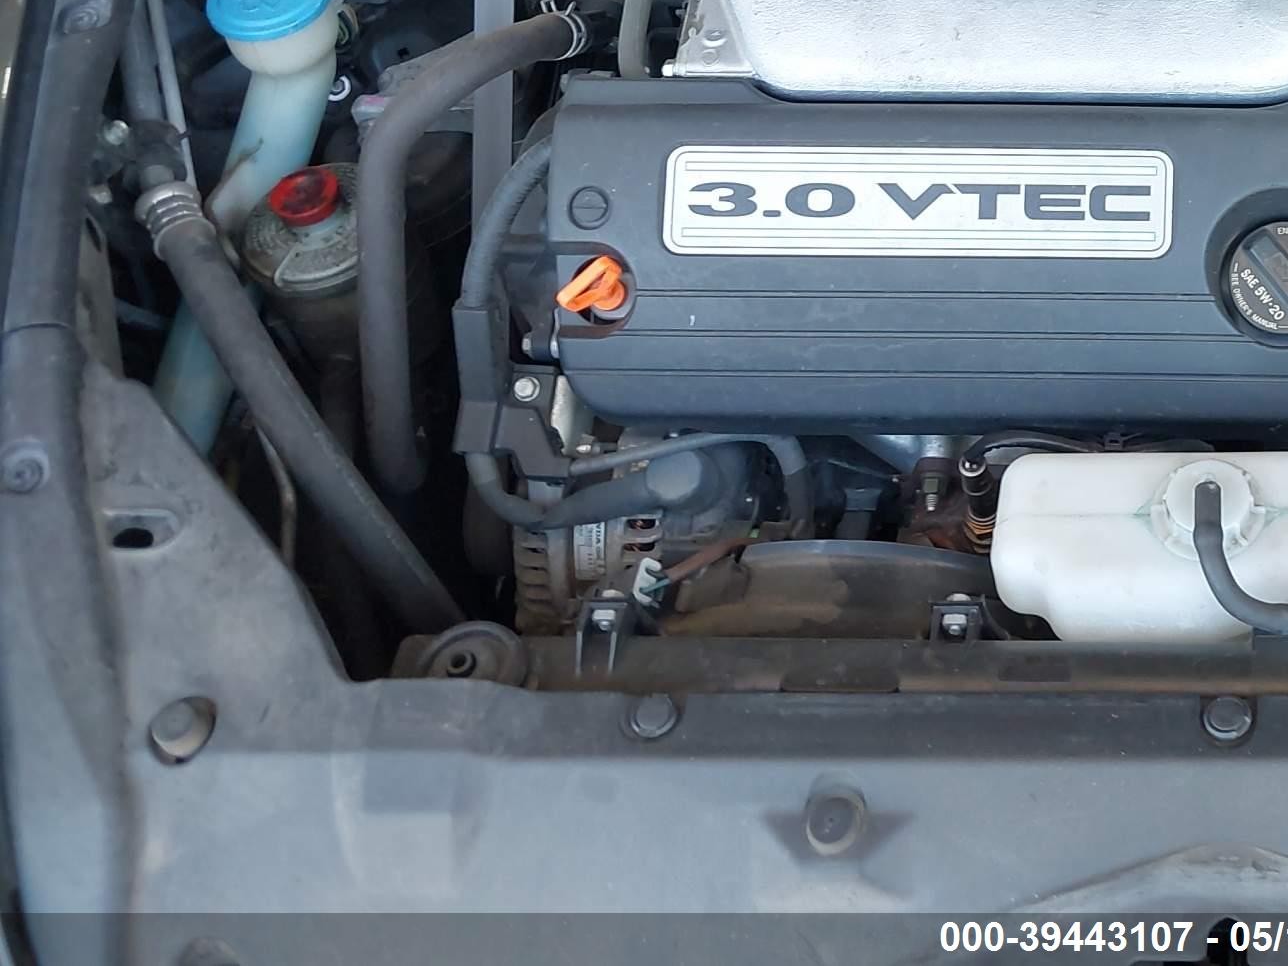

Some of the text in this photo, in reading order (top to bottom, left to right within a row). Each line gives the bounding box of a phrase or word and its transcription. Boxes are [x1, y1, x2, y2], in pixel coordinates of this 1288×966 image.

[688, 181, 1152, 221] 3.0 VTEC
[1241, 268, 1285, 321] SAE 5W-20
[1251, 314, 1279, 330] MANUAL
